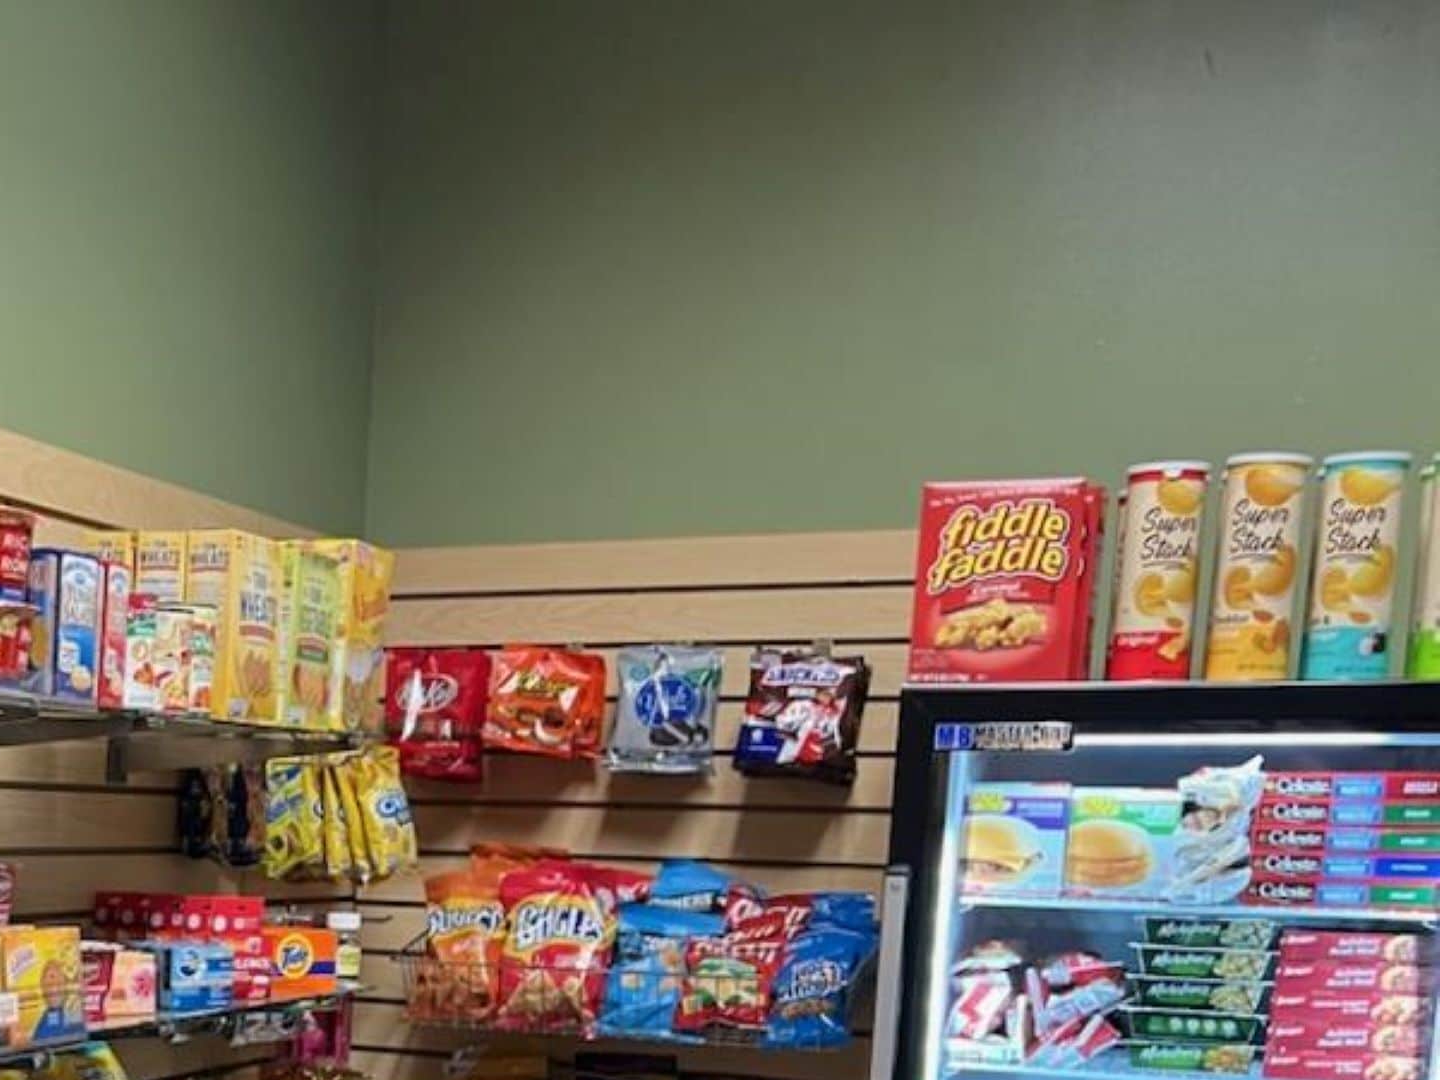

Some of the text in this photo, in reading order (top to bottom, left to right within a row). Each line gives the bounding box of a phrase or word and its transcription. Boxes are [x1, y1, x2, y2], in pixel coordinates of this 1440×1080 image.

[946, 501, 1066, 549] fiddle
[1141, 505, 1196, 534] Super
[1232, 498, 1290, 525] Super
[1327, 498, 1387, 525] Super
[1140, 534, 1193, 561] Stack
[1230, 525, 1285, 554] Stack
[1325, 525, 1382, 554] Stack
[929, 536, 1065, 592] faddle
